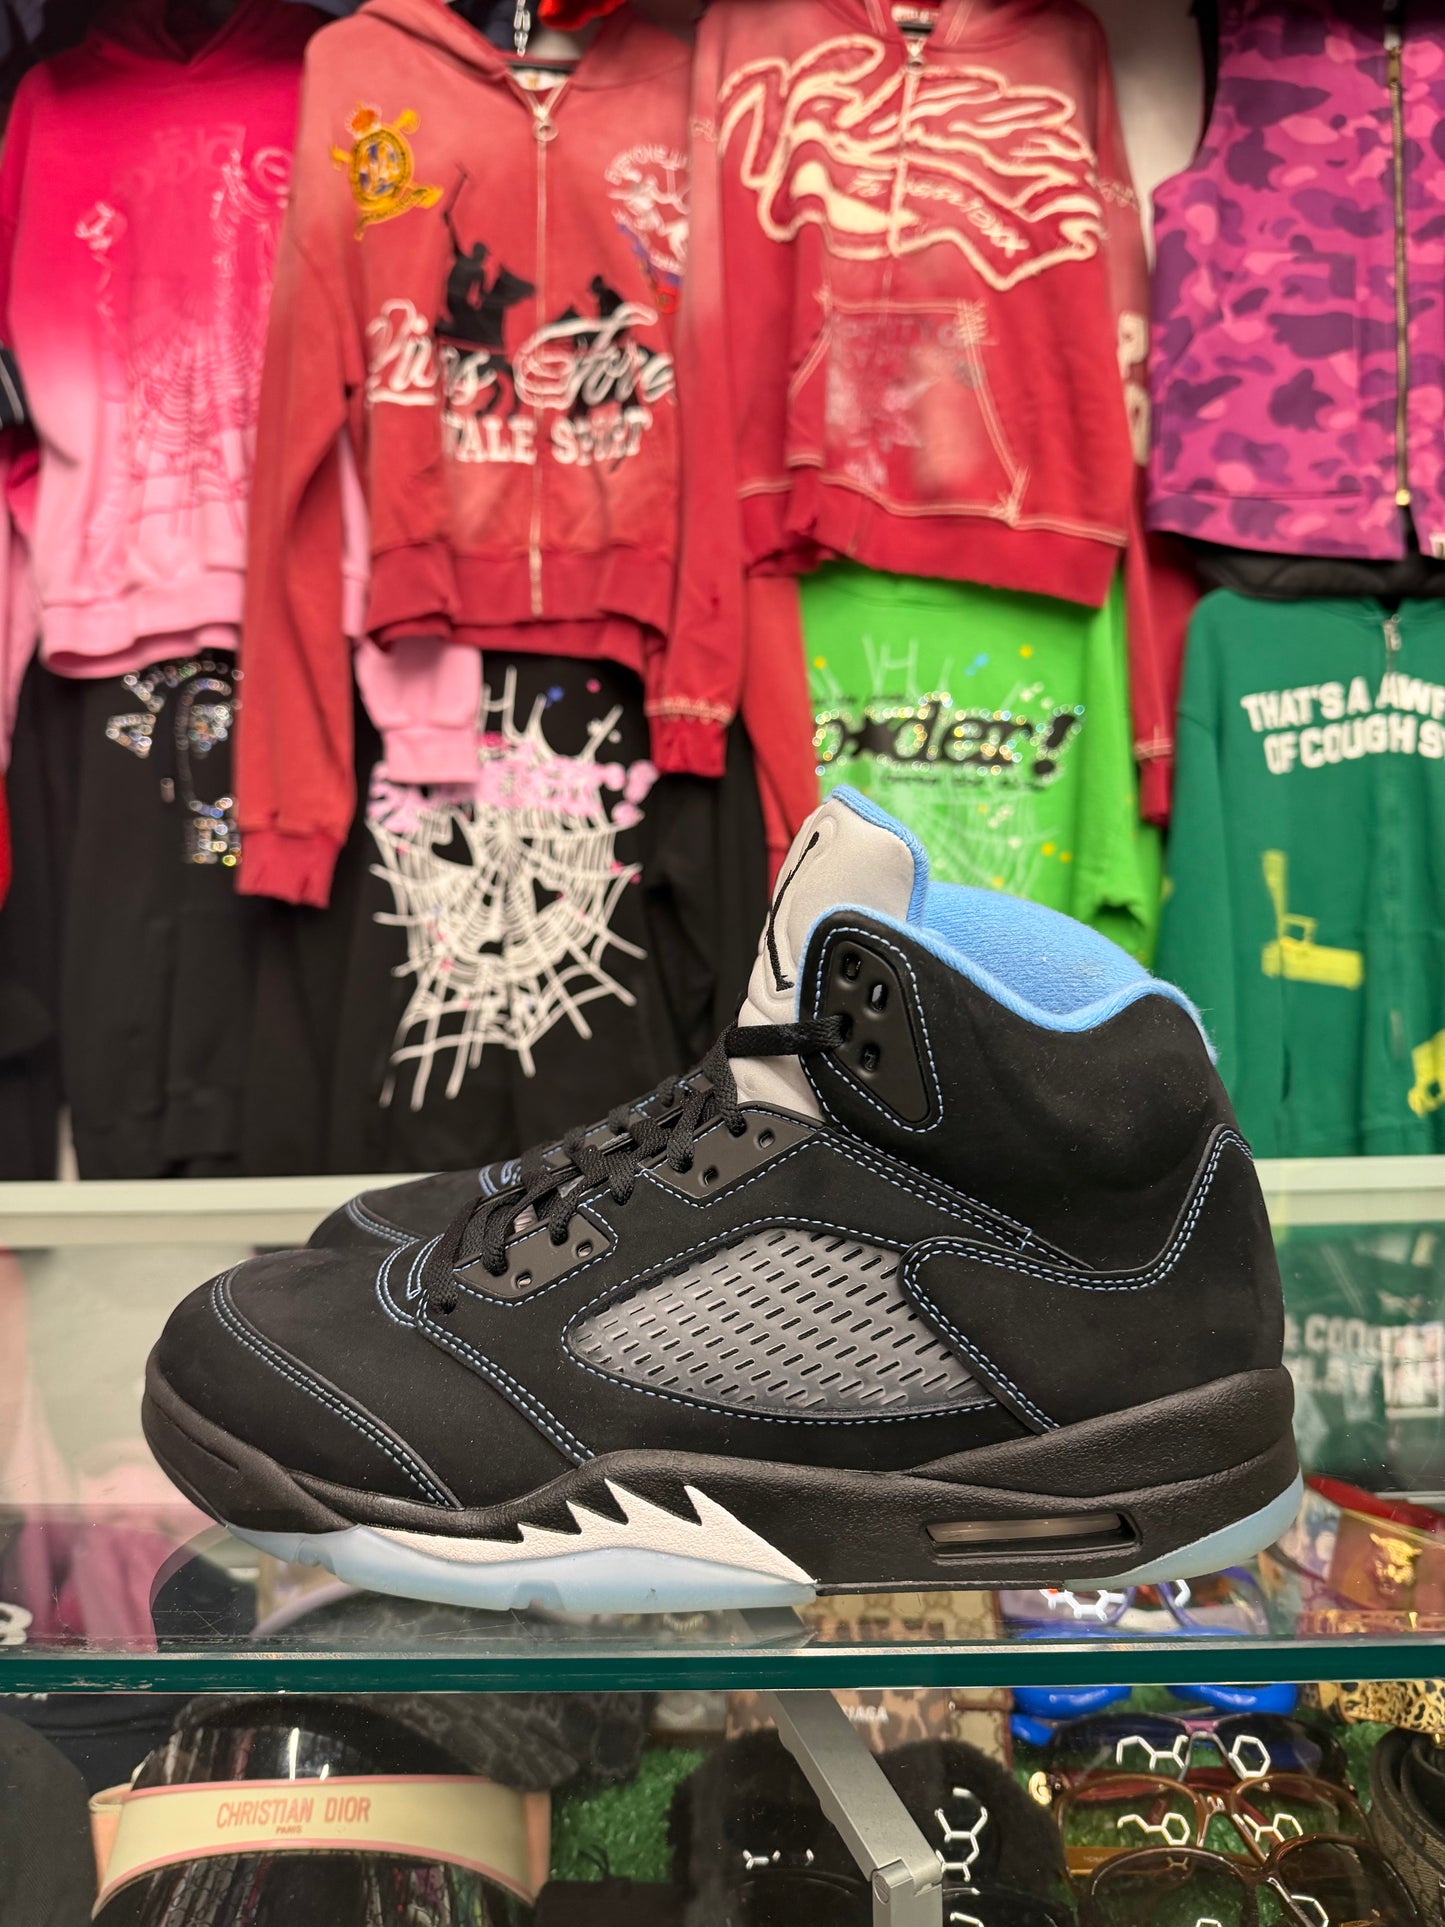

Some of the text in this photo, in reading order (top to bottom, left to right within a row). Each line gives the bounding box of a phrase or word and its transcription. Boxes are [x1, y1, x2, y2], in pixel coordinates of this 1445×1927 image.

[1240, 681, 1346, 732] THAT'S
[1346, 675, 1372, 715] A
[1263, 731, 1298, 775] OF
[1300, 712, 1417, 768] COUGH
[215, 1796, 372, 1829] CHRISTIAN DIOR
